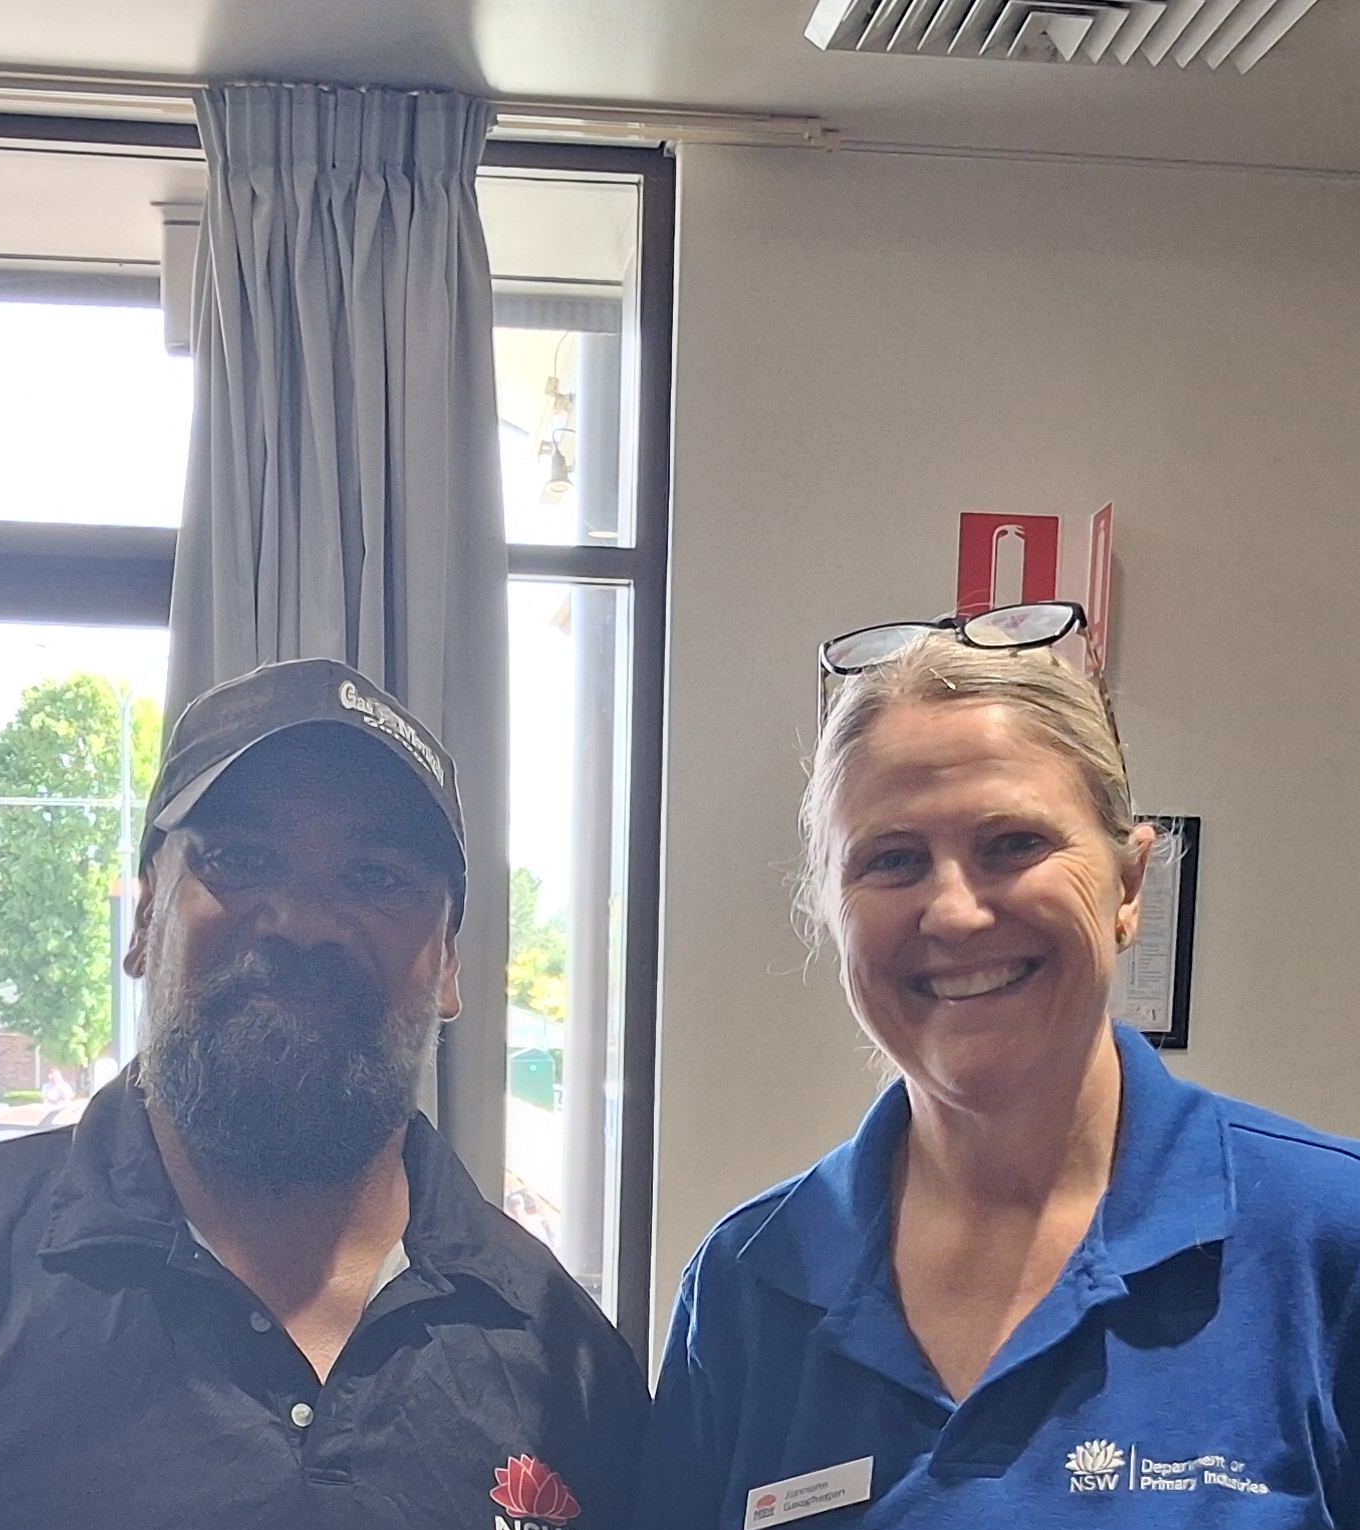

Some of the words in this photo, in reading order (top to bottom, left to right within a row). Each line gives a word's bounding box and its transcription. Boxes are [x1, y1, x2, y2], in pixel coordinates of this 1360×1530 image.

[1141, 1455, 1226, 1477] Department
[1069, 1474, 1120, 1493] NSW
[1140, 1476, 1198, 1492] Primary
[1203, 1470, 1271, 1495] Industries
